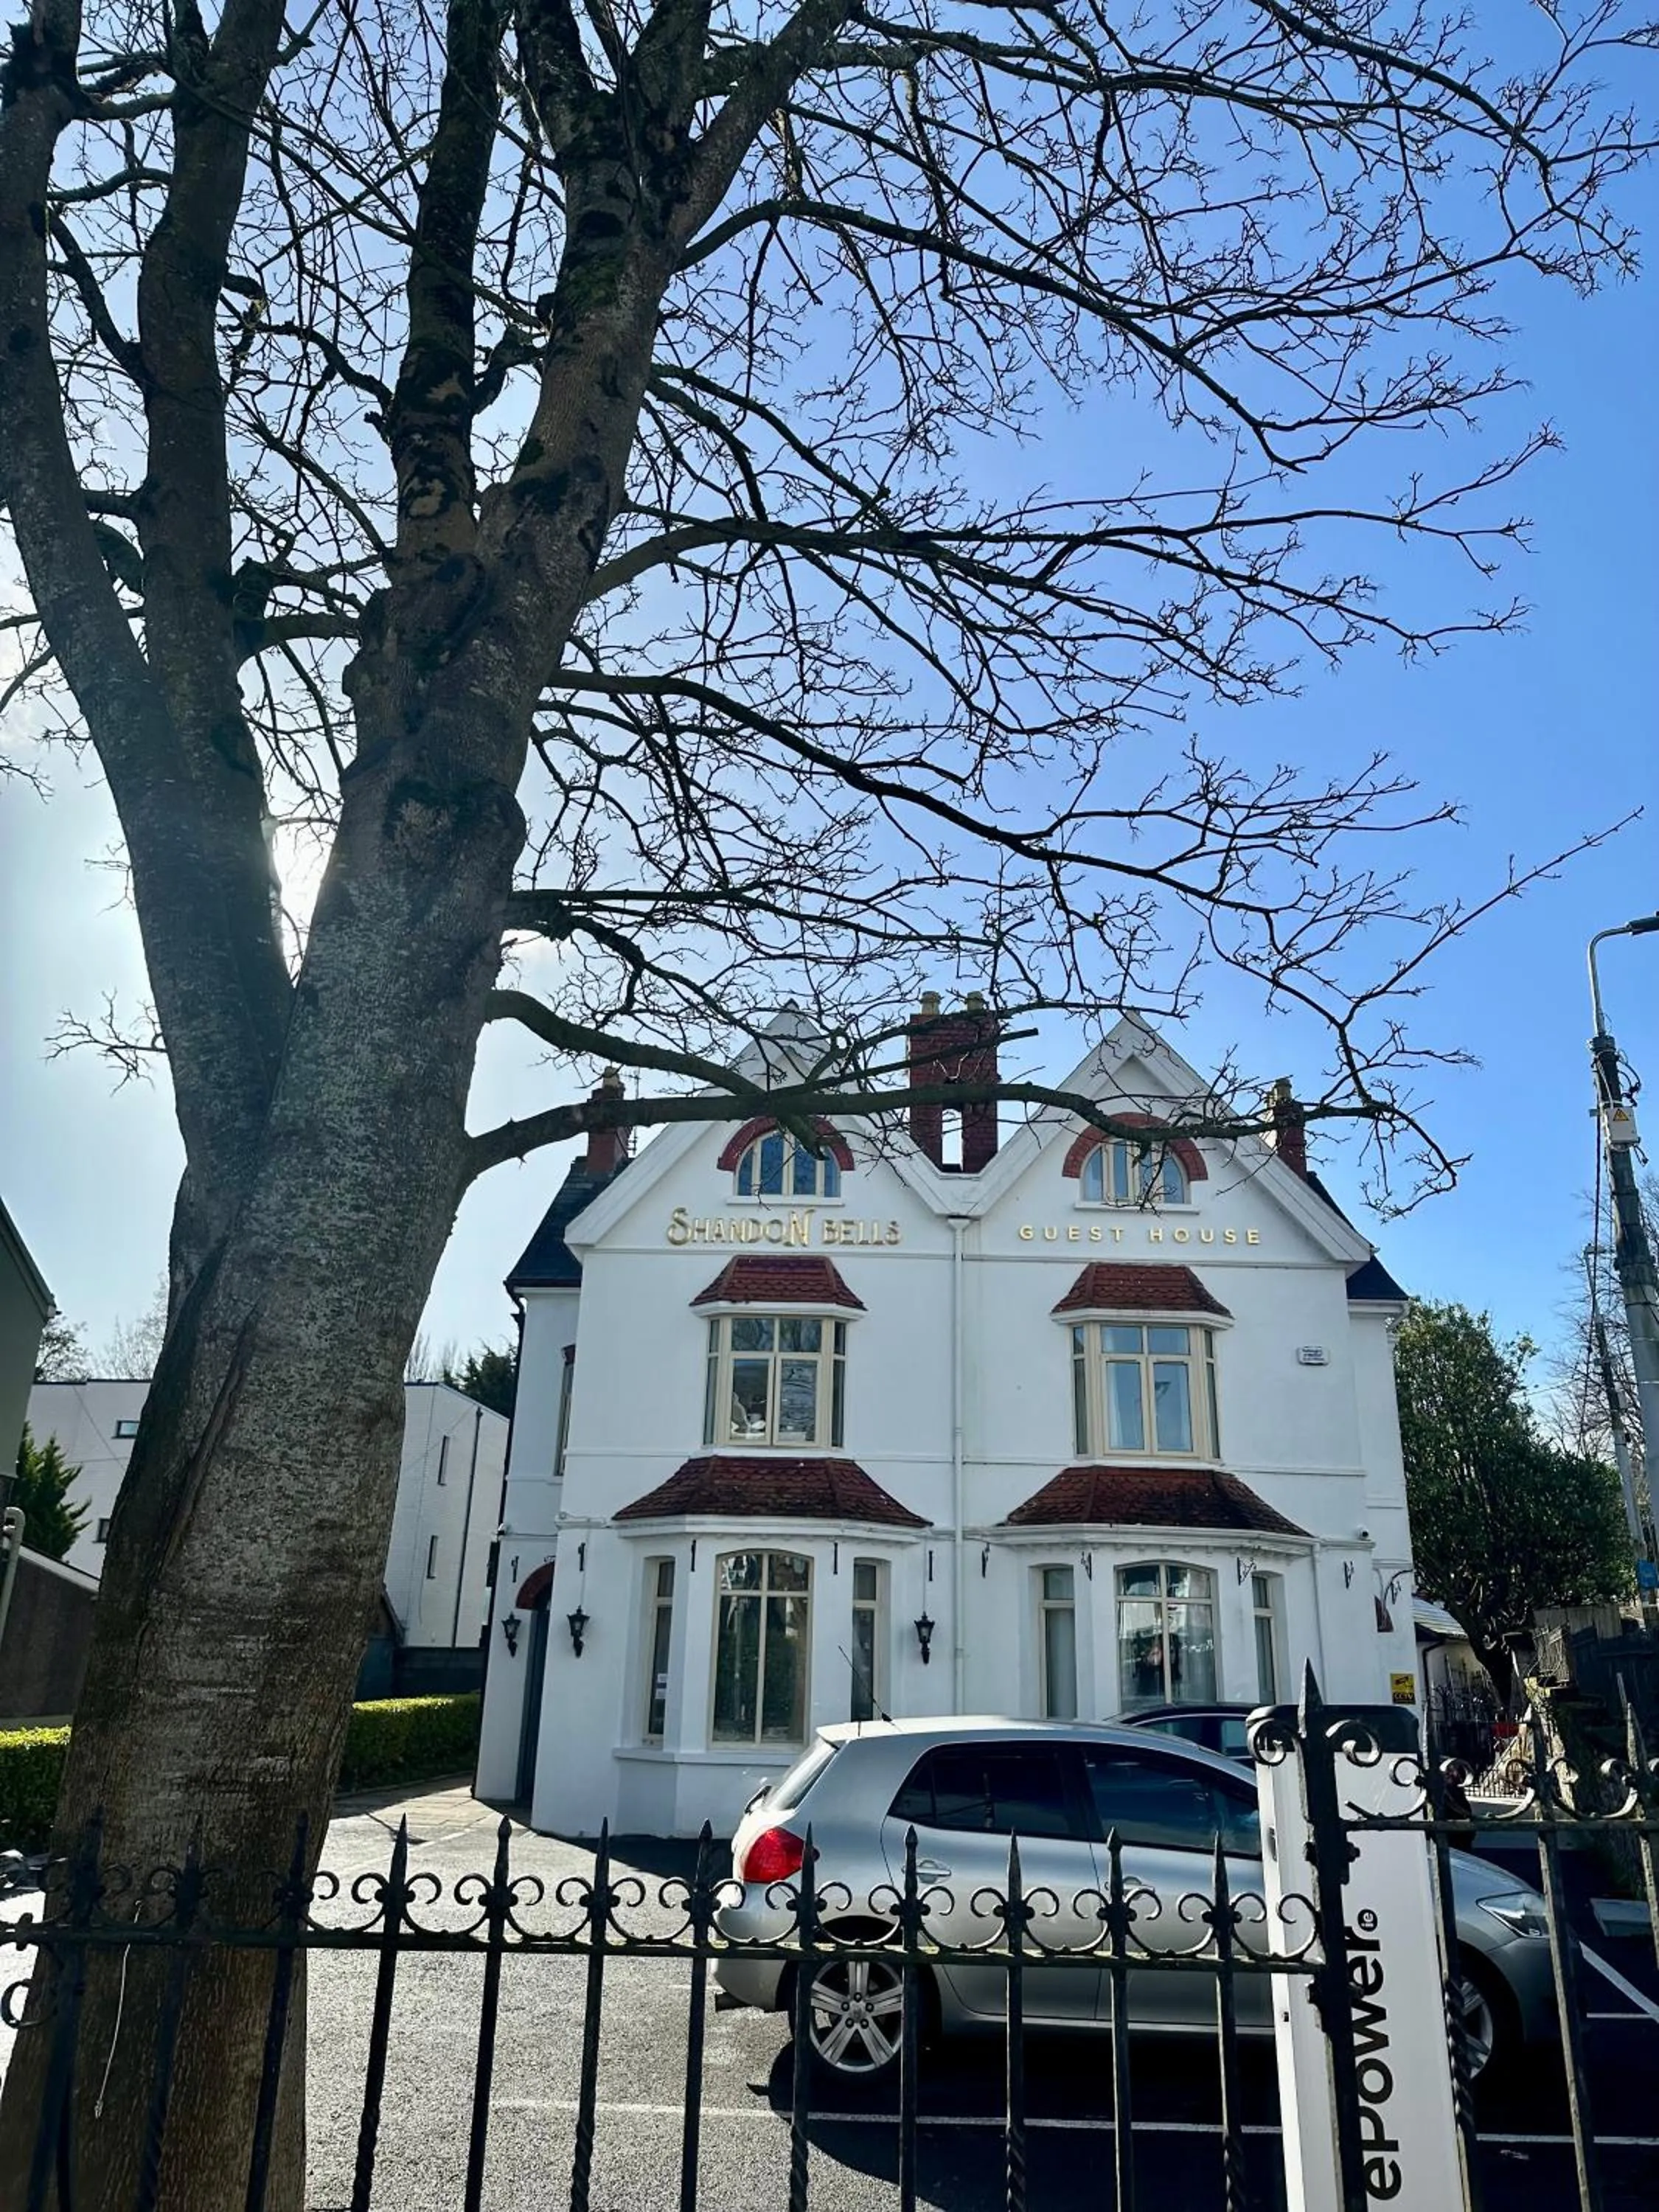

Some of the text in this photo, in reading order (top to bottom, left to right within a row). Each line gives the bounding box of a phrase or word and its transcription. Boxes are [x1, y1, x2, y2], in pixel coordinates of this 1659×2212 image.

[667, 1207, 902, 1247] SHANDON BELLS
[1019, 1225, 1262, 1245] GUEST HOUSE
